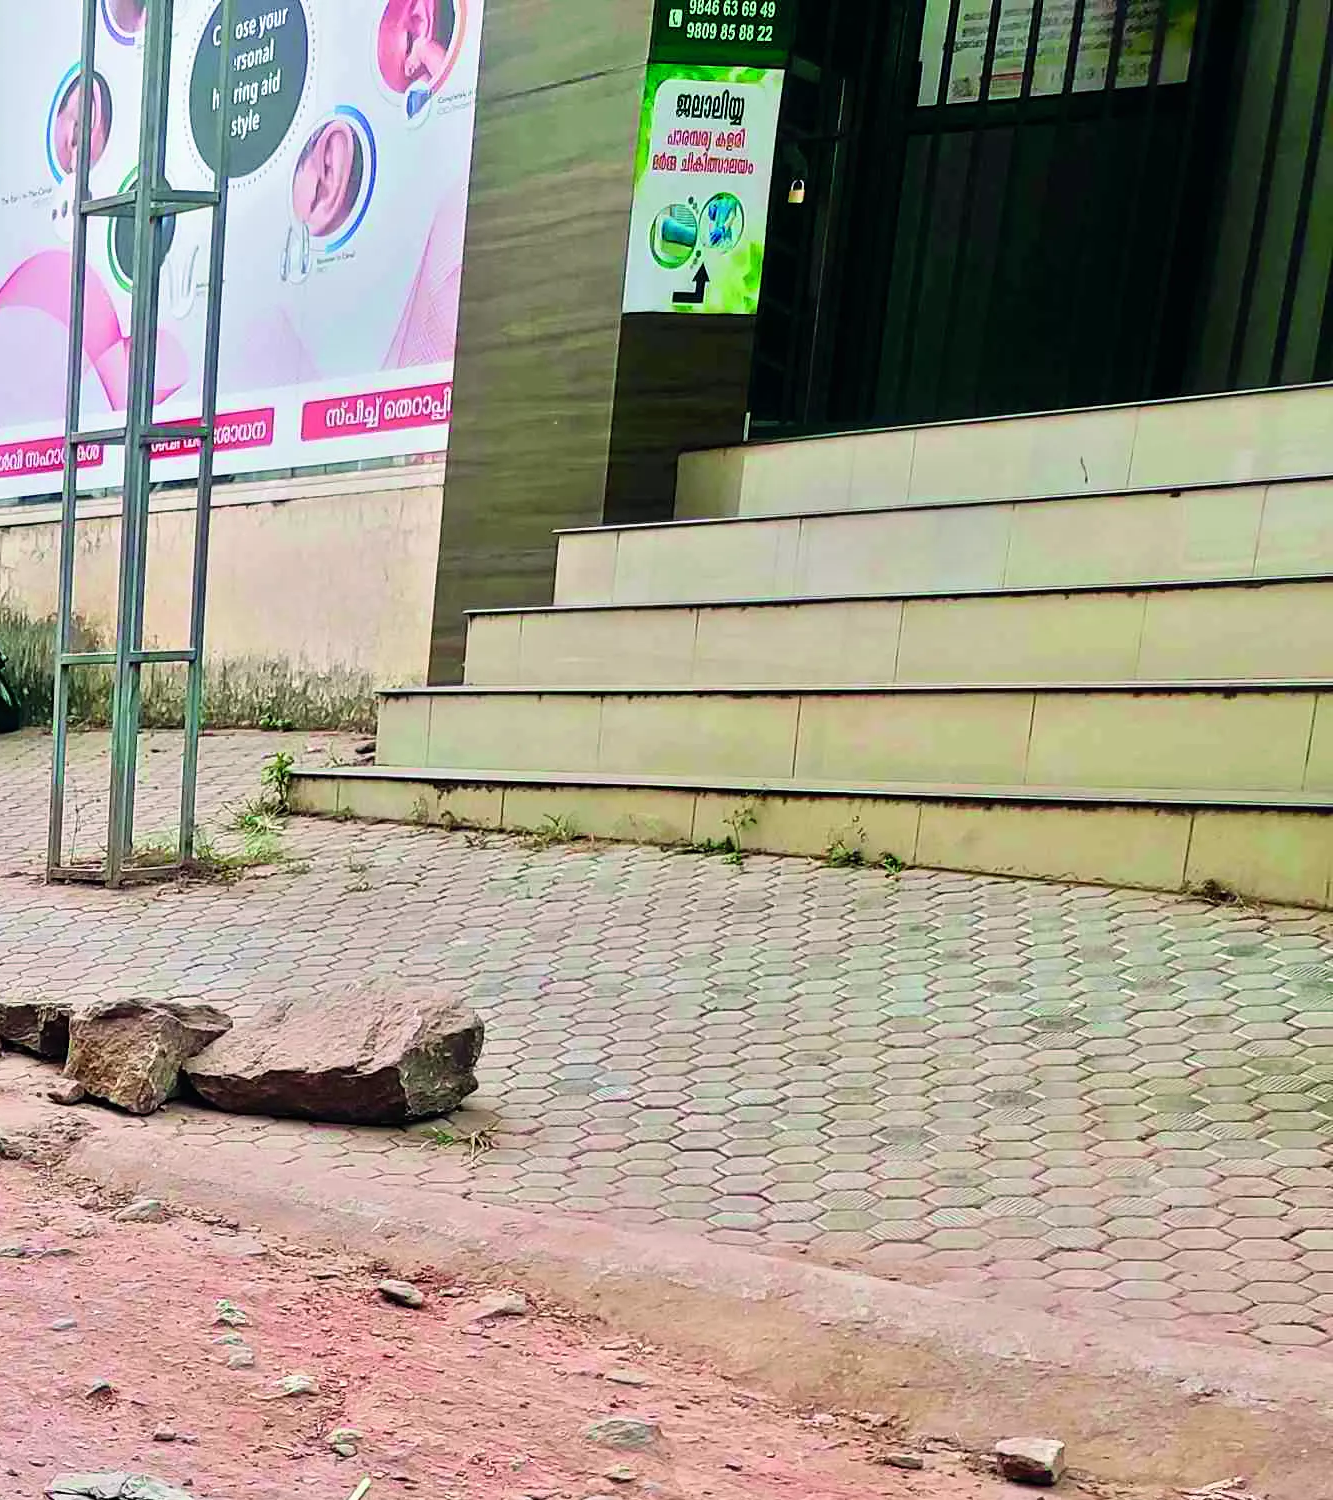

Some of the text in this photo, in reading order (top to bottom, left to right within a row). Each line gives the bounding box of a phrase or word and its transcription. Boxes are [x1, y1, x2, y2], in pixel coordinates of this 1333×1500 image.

[689, 0, 776, 18] 9846 63 69 49
[213, 8, 288, 46] Cose your
[686, 22, 773, 42] 9809 85 88 22
[234, 38, 274, 71] rsonal
[213, 68, 281, 111] hring aid
[230, 108, 260, 140] style
